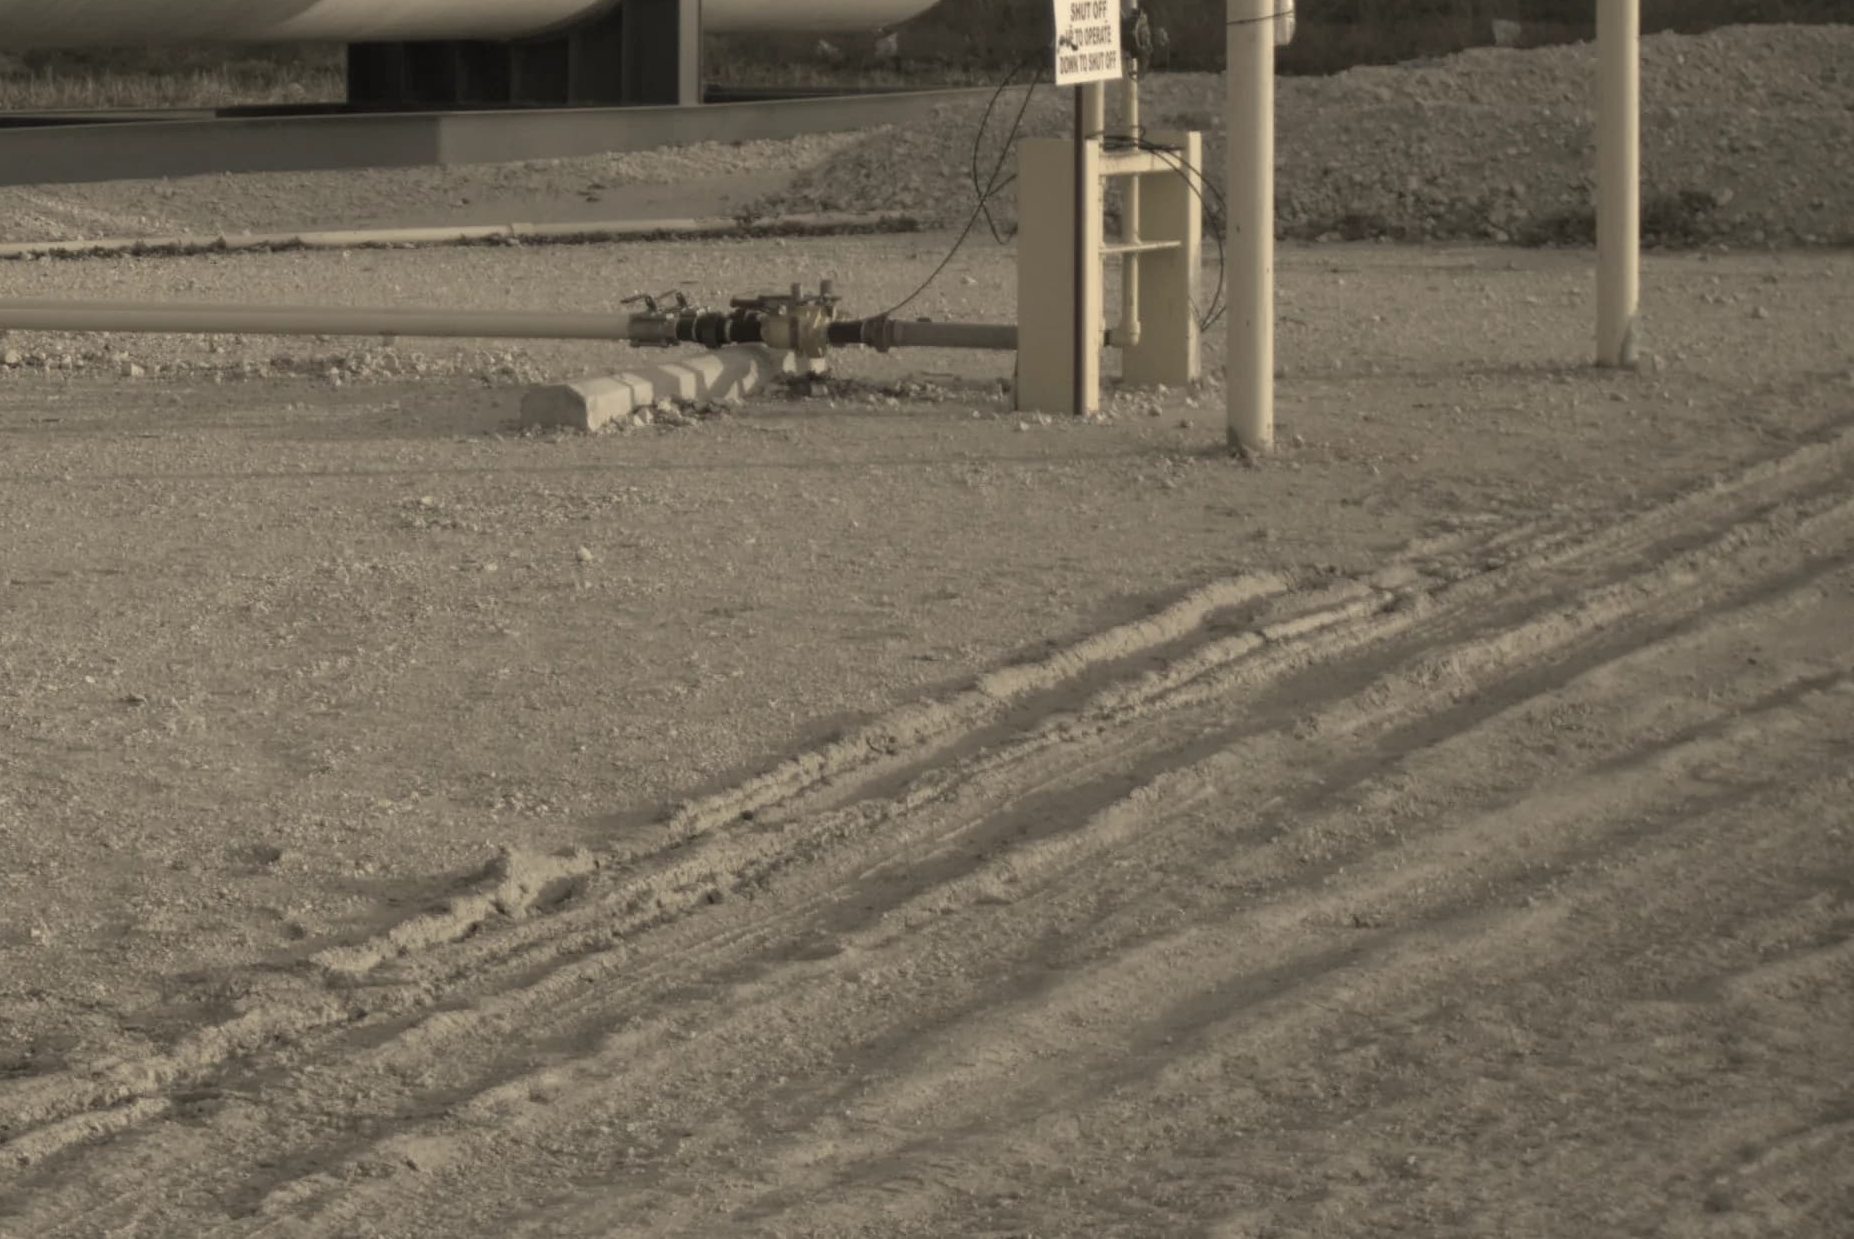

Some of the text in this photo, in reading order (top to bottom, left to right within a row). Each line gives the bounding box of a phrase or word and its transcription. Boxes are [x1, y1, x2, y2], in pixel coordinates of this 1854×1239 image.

[1070, 0, 1107, 22] SHUT OFF
[1074, 28, 1083, 47] TO
[1084, 25, 1112, 46] OPERATE
[1059, 50, 1116, 75] DOWN TO SHUT OFF
